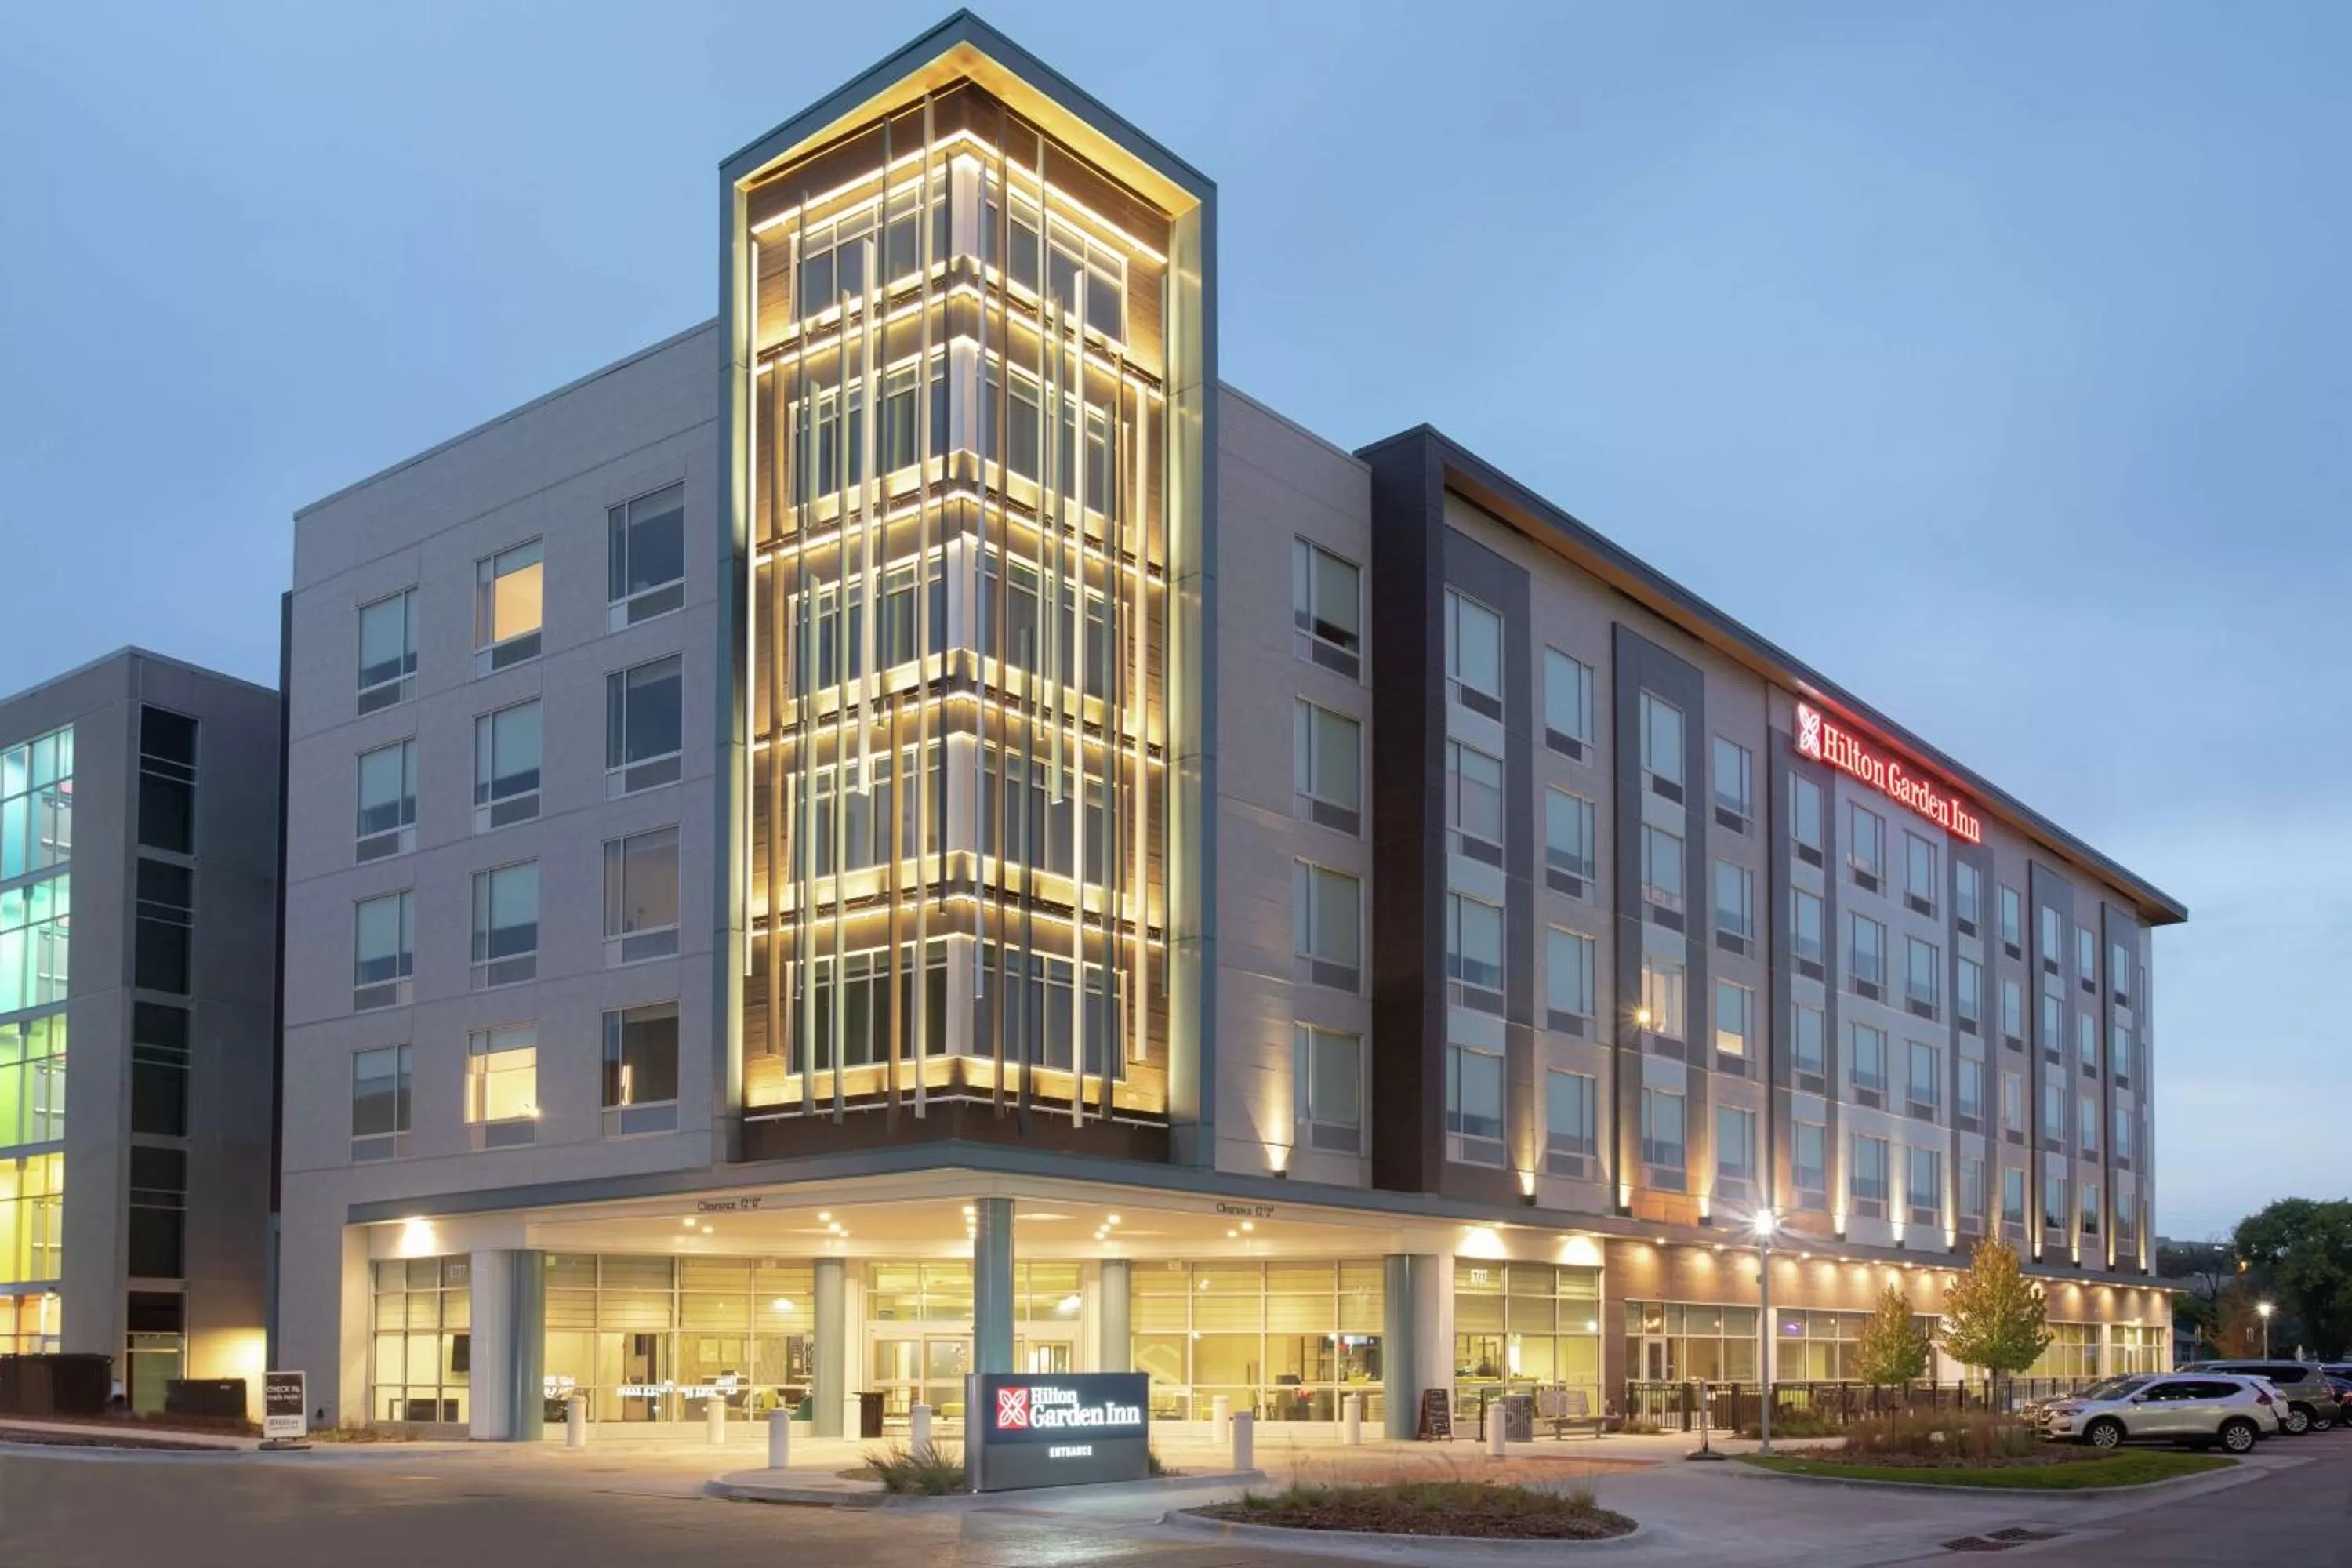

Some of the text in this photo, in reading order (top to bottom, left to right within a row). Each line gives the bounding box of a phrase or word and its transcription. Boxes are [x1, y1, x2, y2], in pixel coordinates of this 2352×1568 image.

[1823, 723, 1981, 843] Hilton Garden Inn
[1030, 1386, 1079, 1405] Hilton
[1029, 1402, 1141, 1428] Garden Inn
